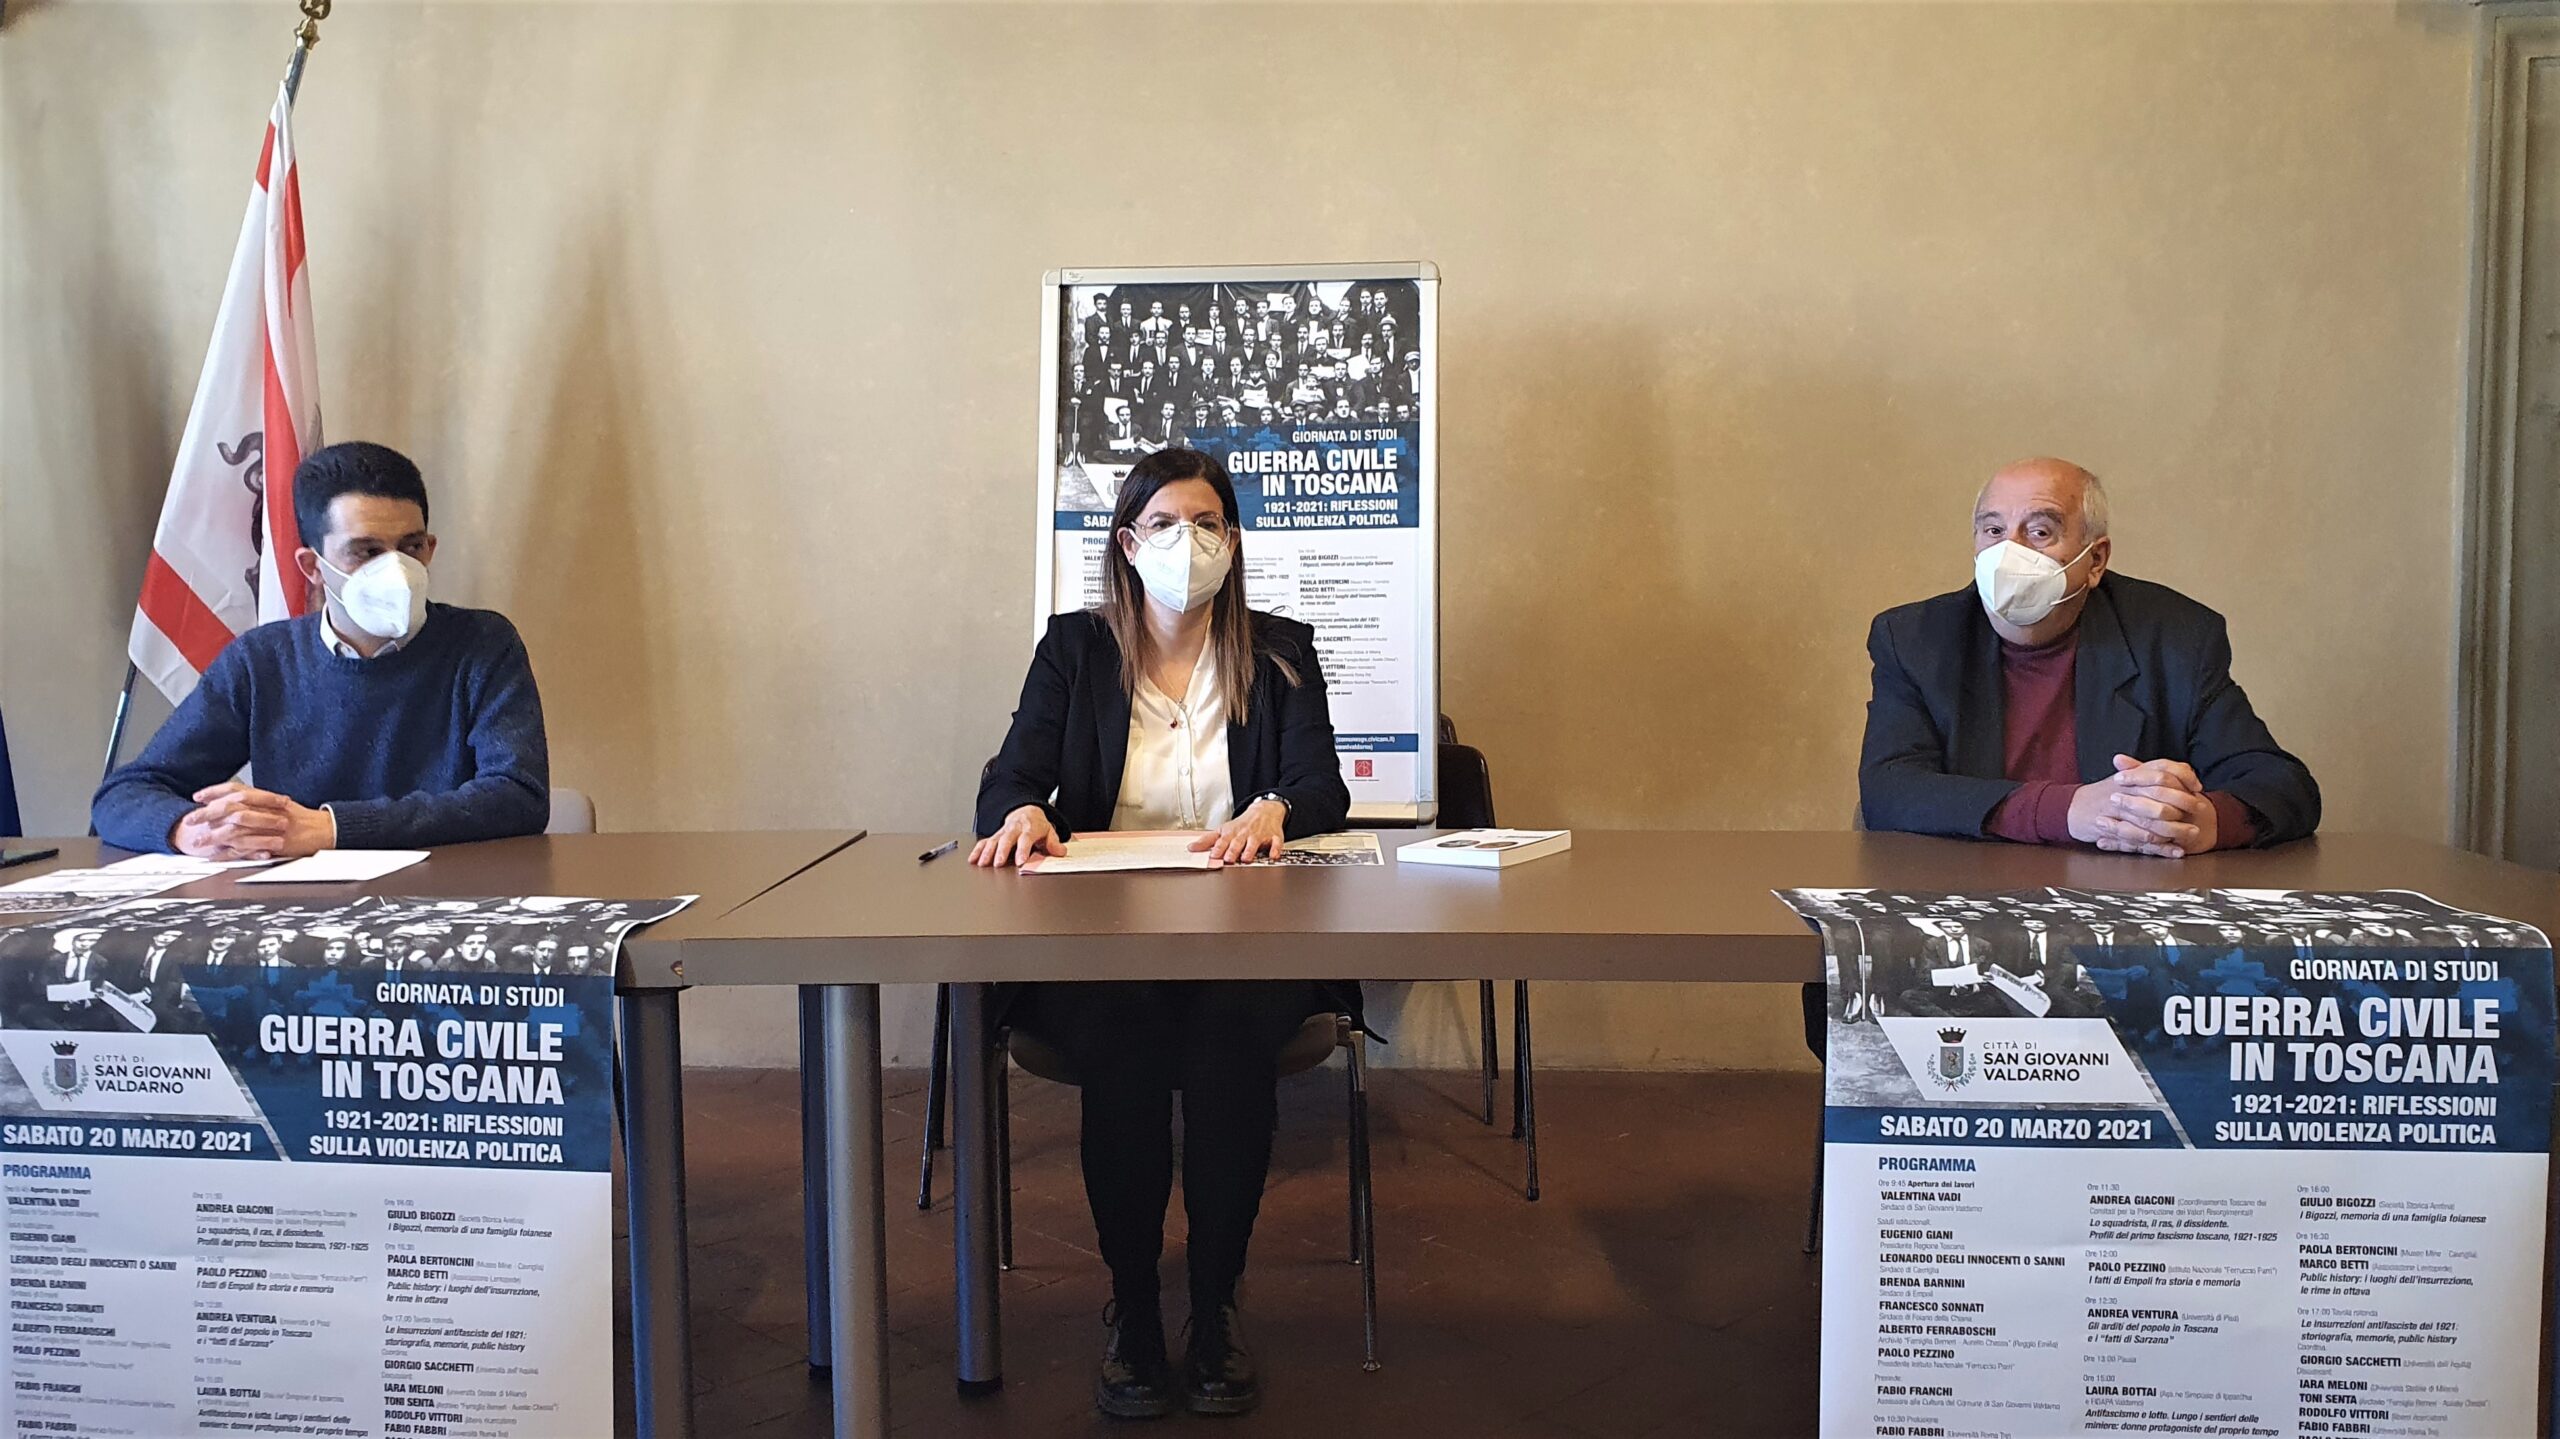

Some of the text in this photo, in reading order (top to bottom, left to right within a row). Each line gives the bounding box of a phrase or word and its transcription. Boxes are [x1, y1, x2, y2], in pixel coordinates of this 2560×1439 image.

[1292, 428, 1397, 443] GIORNATA DI STUDI
[1228, 448, 1397, 474] GUERRA CIVILE
[1262, 472, 1400, 496] IN TOSCANA
[1264, 499, 1398, 513] 1921-2021: RIFLESSIONI
[1255, 513, 1398, 528] SULLA VIOLENZA POLITICA
[2290, 959, 2499, 982] GIORNATA DI STUDI
[376, 982, 564, 1008] GIORNATA DI STUDI
[2163, 994, 2500, 1039] GUERRA CIVILE
[259, 1013, 563, 1062] GUERRA CIVILE
[1983, 1040, 2018, 1050] CITTÀ
[94, 1053, 126, 1063] CITTÀ
[1983, 1052, 2109, 1067] SAN GIOVANNI
[2230, 1041, 2499, 1084] IN TOSCANA
[95, 1064, 211, 1080] SAN GIOVANNI
[1983, 1068, 2081, 1082] VALDARNO
[95, 1079, 184, 1094] VALDARNO
[321, 1059, 565, 1105] IN TOSCANA
[2231, 1094, 2497, 1117] 1921-2021: RIFLESSIONI
[324, 1109, 564, 1137] 1921-2021: RIFLESSIONI
[1880, 1115, 2152, 1140] SABATO 20 MARZO 2021
[3, 1124, 252, 1151] SABATO 20 MARZO 2021
[2215, 1121, 2496, 1144] SULLA VIOLENZA POLITICA
[309, 1134, 563, 1164] SULLA VIOLENZA POLITICA
[1878, 1157, 1976, 1172] PROGRAMMA
[3, 1164, 91, 1180] PROGRAMMA
[1907, 1180, 1939, 1189] Apertura
[1881, 1191, 1961, 1202] VALENTINA VADI
[2090, 1195, 2175, 1206] ANDREA GIACONI
[2300, 1197, 2376, 1208] GIULIO BIGOZZI
[196, 1204, 234, 1213] ANDREA
[236, 1204, 274, 1215] GIACONI
[387, 1210, 456, 1222] GIULIO BIGOZZI
[2300, 1211, 2487, 1224] I Bigozzi, memoria di una famiglia foianese
[1880, 1229, 1953, 1240] EUGENIO GIANI
[2299, 1244, 2332, 1254] PAOLA
[2336, 1245, 2398, 1256] BERTONCINI
[387, 1254, 474, 1267] PAOLA BERTONCINI
[1880, 1253, 2065, 1266] LEONARDO DEGLI INNOCENTI O SANNI
[2300, 1259, 2369, 1270] MARCO BETTI
[2088, 1262, 2166, 1273] PAOLO PEZZINO
[387, 1268, 448, 1280] MARCO BETTI
[1880, 1277, 1965, 1288] BRENDA BARNINI
[2088, 1276, 2092, 1284] I
[2094, 1276, 2112, 1285] fatti
[2113, 1276, 2122, 1285] di
[2124, 1276, 2153, 1288] Empoli
[2155, 1277, 2167, 1286] fra
[2168, 1277, 2193, 1286] storia
[2203, 1278, 2241, 1287] memoria
[1879, 1301, 1984, 1313] FRANCESCO SONNATI
[196, 1312, 277, 1324] ANDREA VENTURA
[2087, 1308, 2178, 1320] ANDREA VENTURA
[1879, 1324, 1996, 1336] ALBERTO FERRABOSCHI
[1878, 1348, 1954, 1359] PAOLO PEZZINO
[384, 1359, 474, 1373] GIORGIO SACCHETTI
[2300, 1355, 2401, 1367] GIORGIO SACCHETTI
[384, 1383, 443, 1394] IARA MELONI
[1877, 1385, 1953, 1396] FABIO FRANCHI
[2300, 1379, 2367, 1391] IARA MELONI
[197, 1387, 227, 1397] LAURA
[229, 1388, 261, 1398] BOTTAI
[2086, 1386, 2118, 1396] LAURA
[2122, 1387, 2157, 1397] BOTTAI
[384, 1397, 435, 1408] TONI SENTA
[2299, 1393, 2357, 1404] TONI SENTA
[385, 1410, 462, 1423] RODOLFO VITTORI
[2299, 1407, 2389, 1420] RODOLFO VITTORI
[384, 1423, 447, 1436] FABIO FABBRI
[1876, 1426, 1944, 1437] FABIO FABBRI
[2298, 1421, 2370, 1433] FABIO FABBRI
